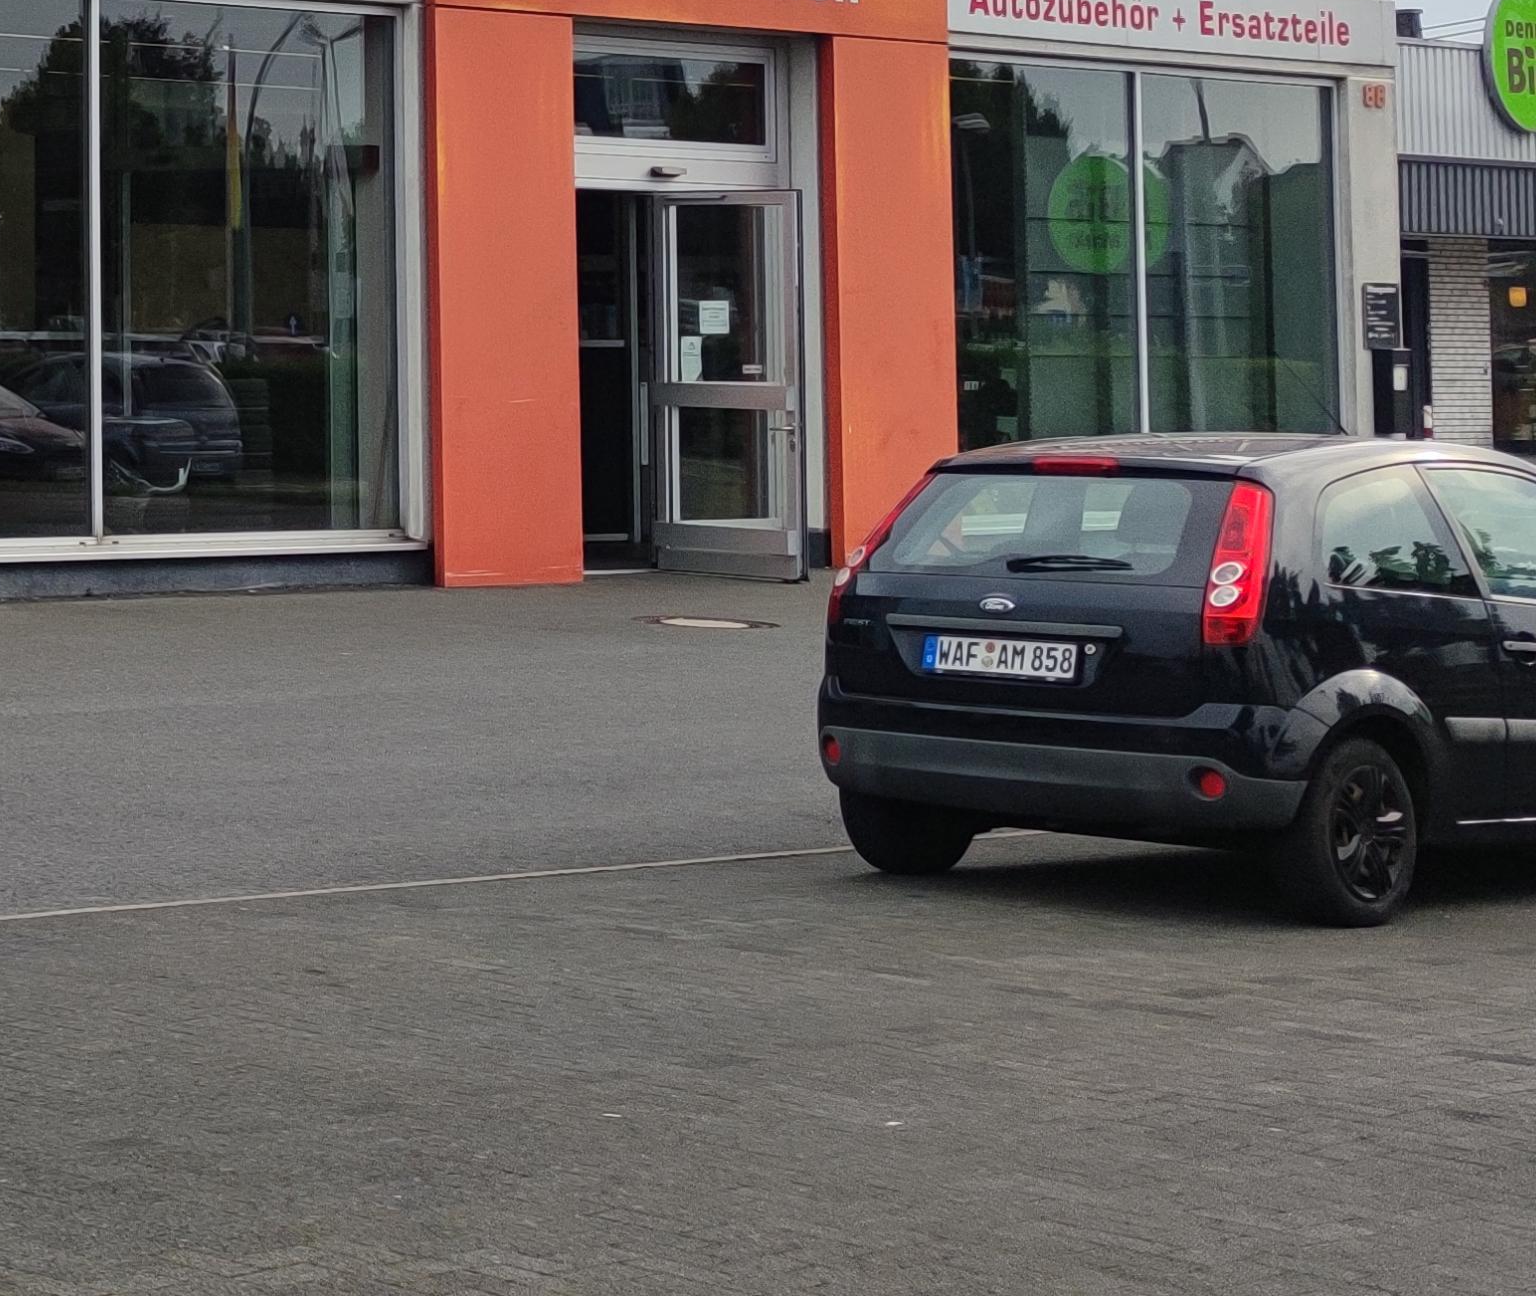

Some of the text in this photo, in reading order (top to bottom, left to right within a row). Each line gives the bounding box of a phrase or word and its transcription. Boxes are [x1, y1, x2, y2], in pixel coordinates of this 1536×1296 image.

[1171, 8, 1187, 33] +
[1199, 0, 1351, 47] Ersatzteile
[938, 639, 981, 667] WAF
[996, 643, 1027, 671] AM
[1030, 645, 1074, 675] 858
